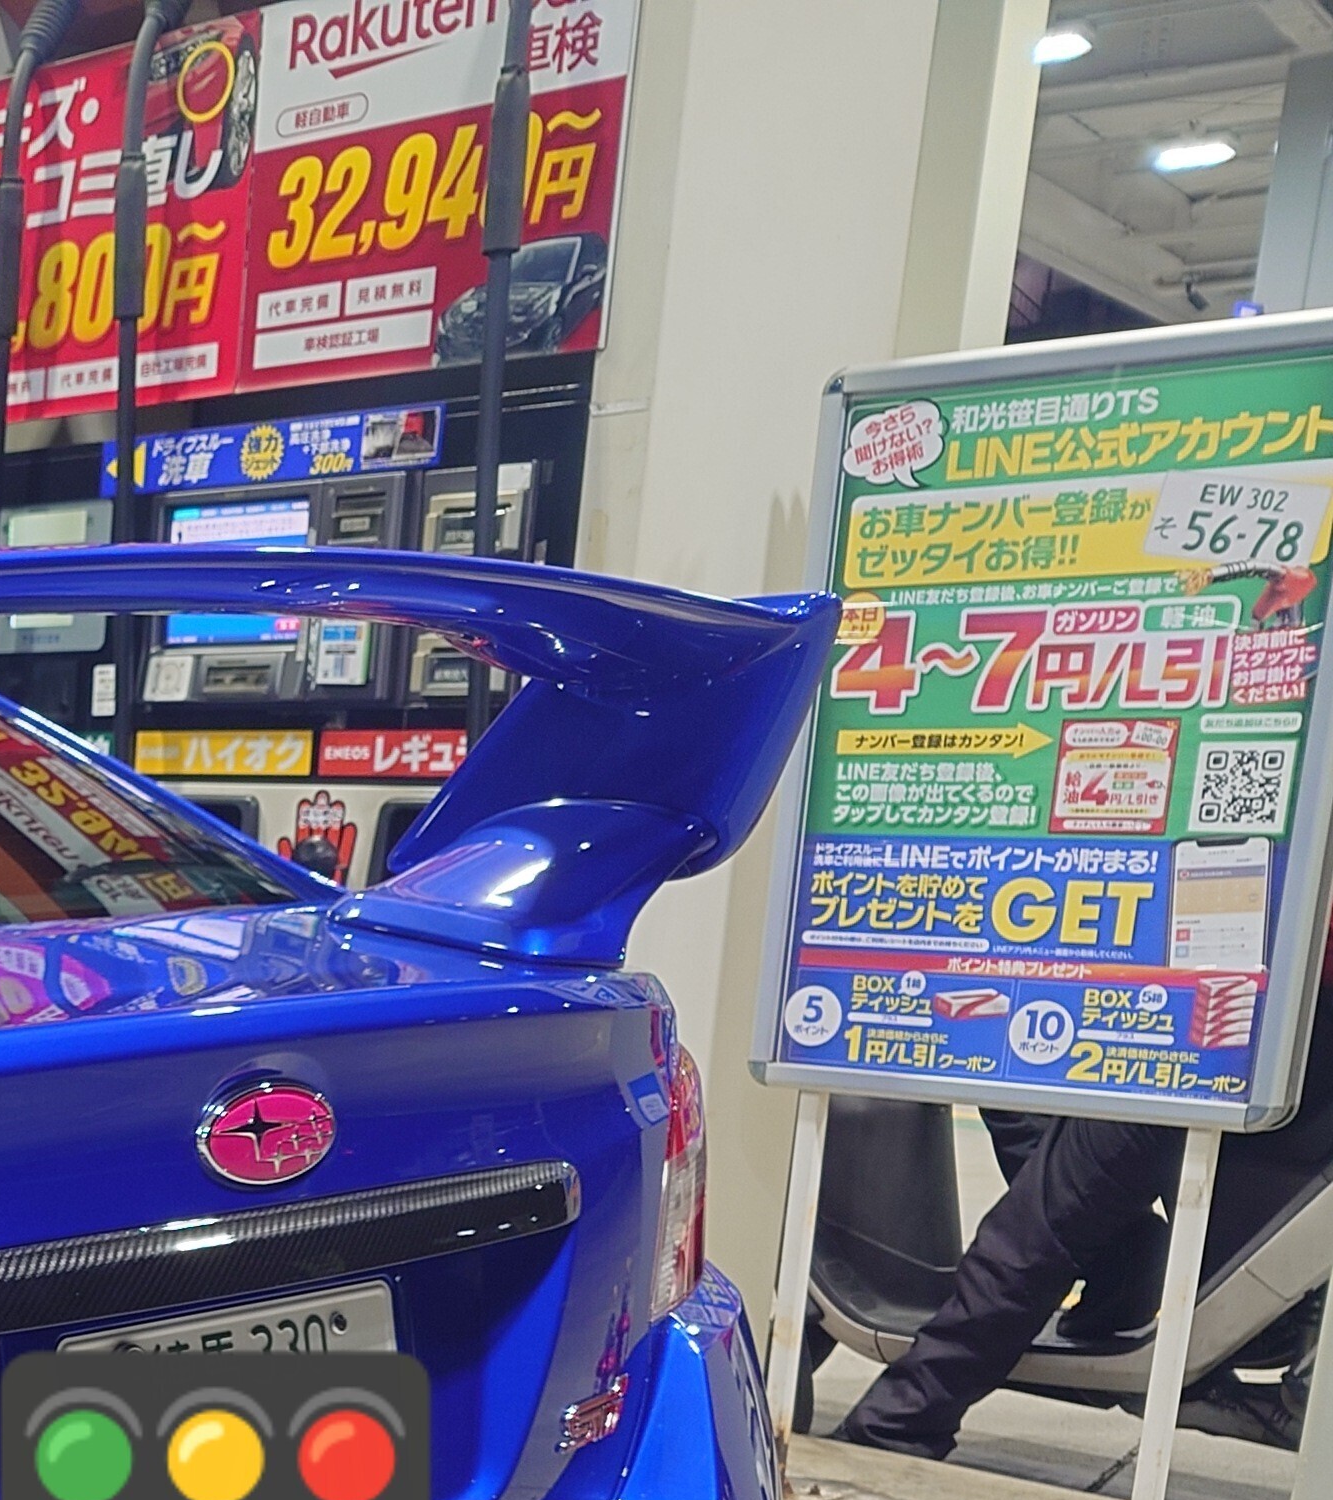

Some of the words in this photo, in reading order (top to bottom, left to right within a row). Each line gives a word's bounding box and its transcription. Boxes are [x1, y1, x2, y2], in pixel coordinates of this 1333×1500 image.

[289, 0, 496, 70] Rakuten
[294, 103, 351, 130] 軽自動車
[864, 404, 917, 437] 今さら
[951, 387, 1159, 434] 和光笹目通りTS
[945, 404, 1333, 482] LINE公式アカウント
[158, 451, 214, 486] 洗車
[859, 487, 1153, 541] お車ナンバー登録が
[1199, 483, 1244, 507] EW
[1246, 488, 1290, 512] 302
[1154, 516, 1177, 540] そ
[1181, 509, 1305, 563] 56-78
[856, 533, 1081, 580] ゼッタイお得!!
[1055, 608, 1138, 632] ガソリン
[184, 735, 306, 773] ハイオク
[324, 747, 371, 761] ENEOS
[810, 872, 988, 900] ポイントを貯めて
[810, 896, 984, 935] プレゼントを
[990, 876, 1154, 947] GET
[852, 974, 896, 993] BOX
[1084, 988, 1133, 1009] BOX
[802, 994, 824, 1023] 5
[851, 992, 933, 1015] ティッシュ
[1024, 1009, 1066, 1042] 10
[1081, 1010, 1175, 1032] ティッシュ
